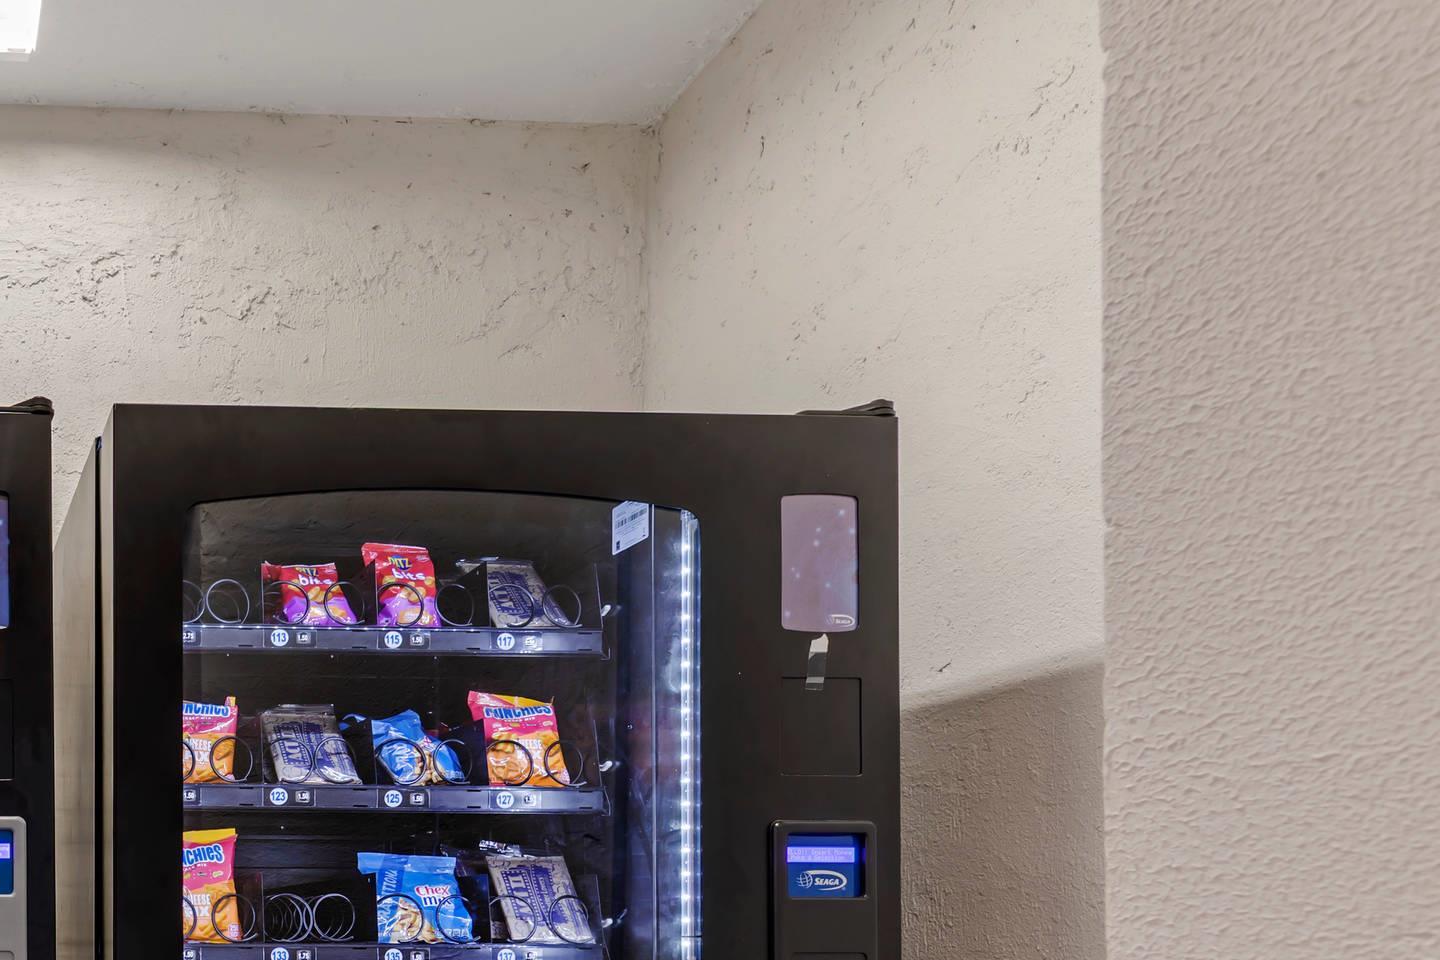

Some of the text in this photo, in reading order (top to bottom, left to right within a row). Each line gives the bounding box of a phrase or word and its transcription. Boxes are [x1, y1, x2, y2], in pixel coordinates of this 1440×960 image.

[392, 568, 426, 581] bits
[272, 632, 287, 643] 113
[385, 634, 401, 645] 115
[497, 635, 512, 647] 117
[270, 791, 286, 801] 123
[385, 793, 401, 803] 125
[498, 795, 513, 805] 127
[814, 877, 840, 886] SEAGA
[415, 885, 450, 897] Chex
[272, 951, 288, 960] 133
